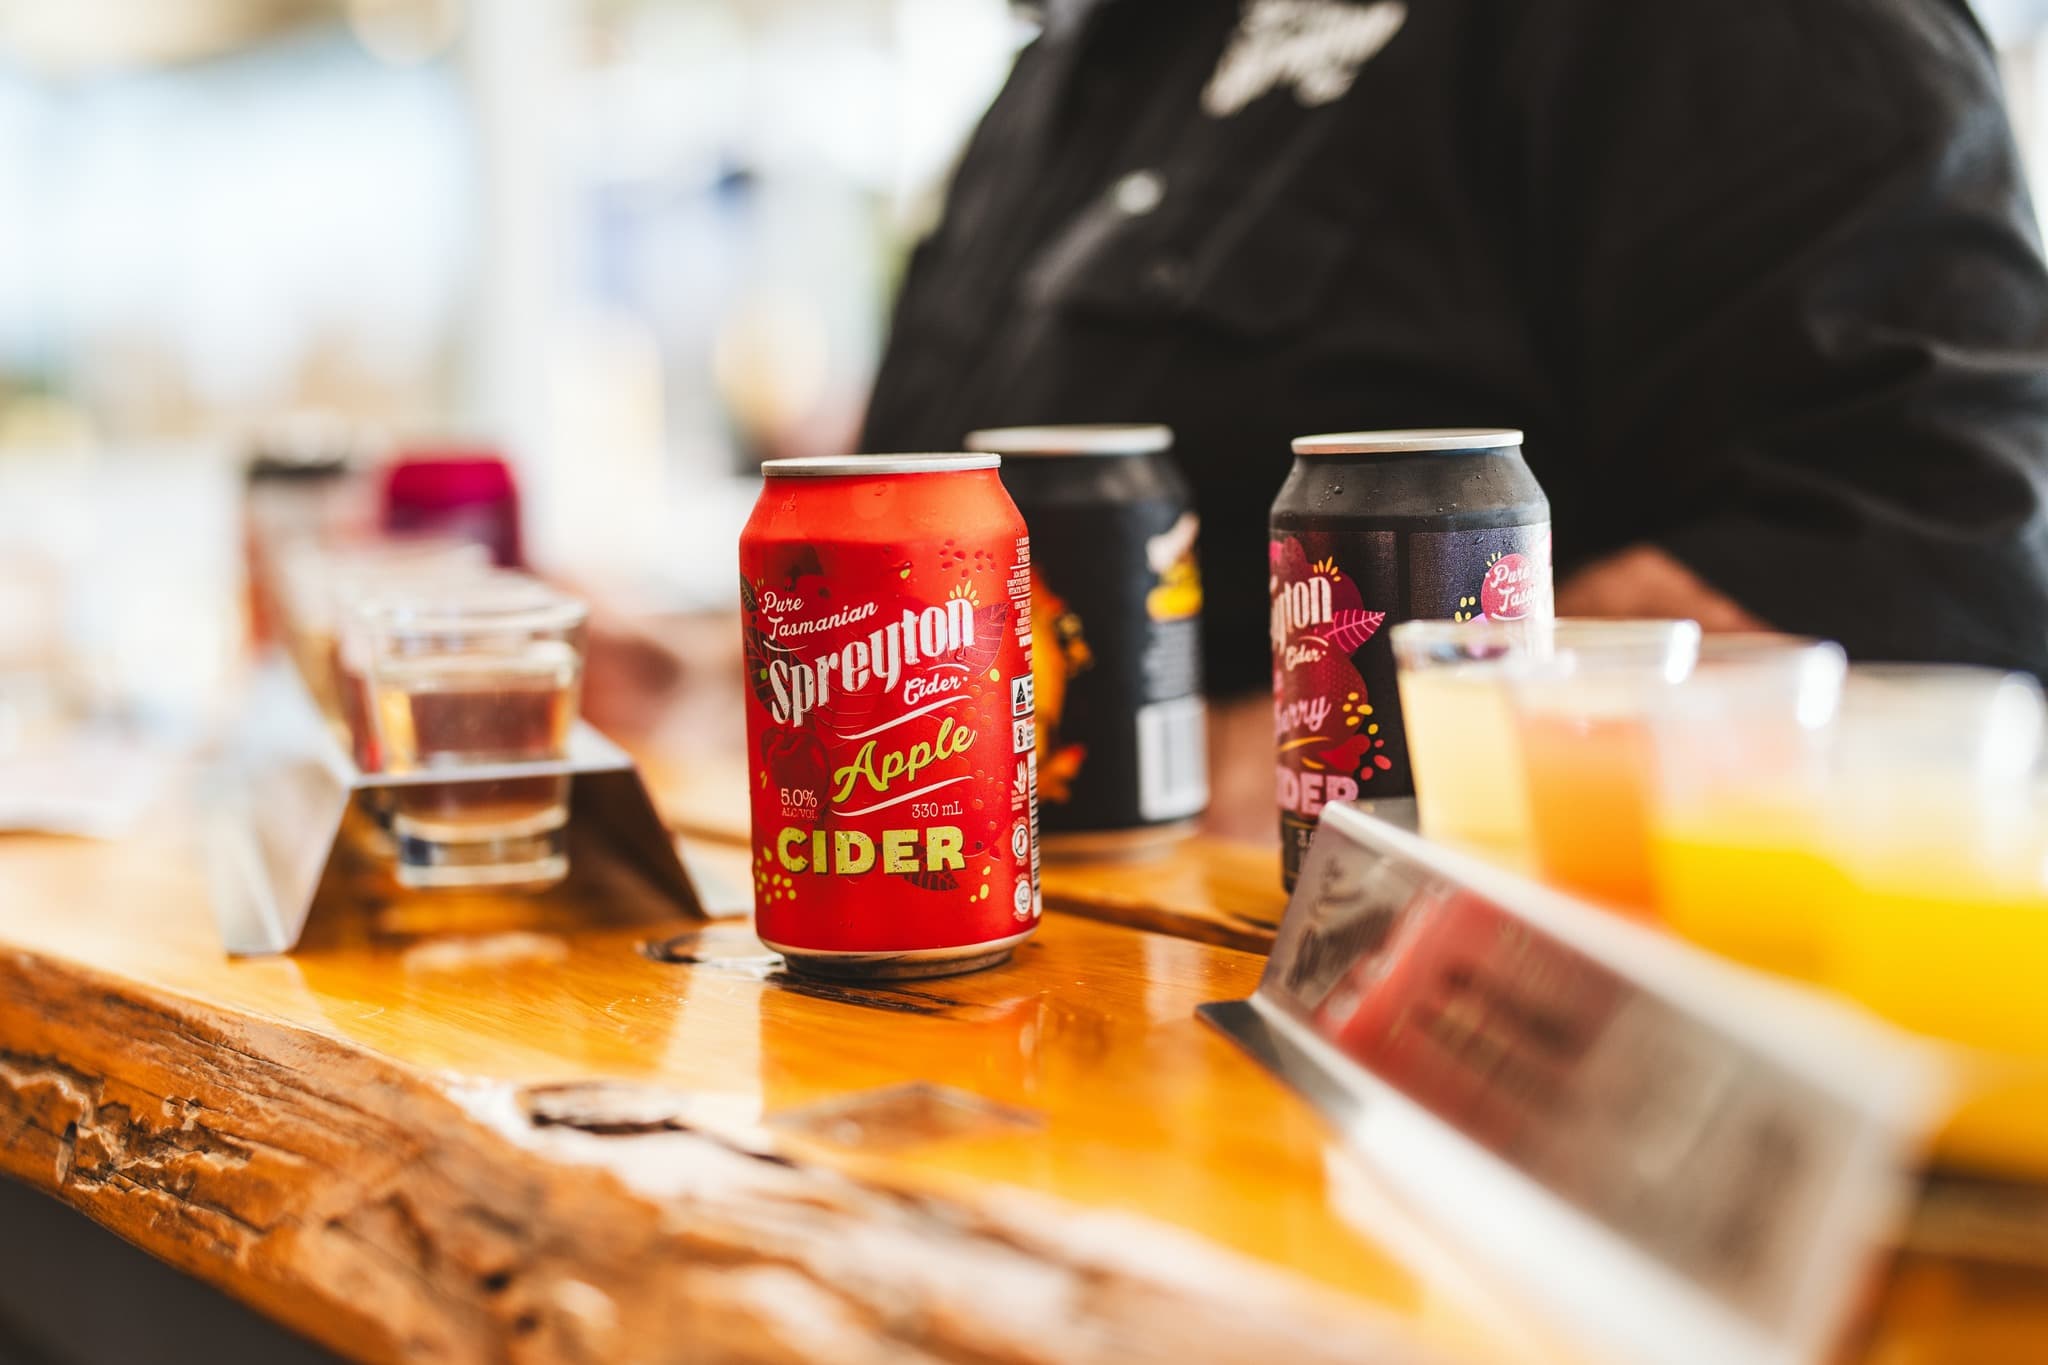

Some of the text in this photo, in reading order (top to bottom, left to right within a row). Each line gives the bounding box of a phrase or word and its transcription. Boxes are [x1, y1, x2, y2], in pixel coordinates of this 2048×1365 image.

[762, 591, 804, 614] Pure
[767, 602, 879, 641] Tasmanian
[768, 598, 976, 728] Spreyton
[903, 673, 962, 705] Cider
[832, 716, 977, 803] Apple
[781, 788, 818, 808] 5.0%
[911, 801, 963, 819] 330 mL
[776, 825, 966, 875] CIDER
